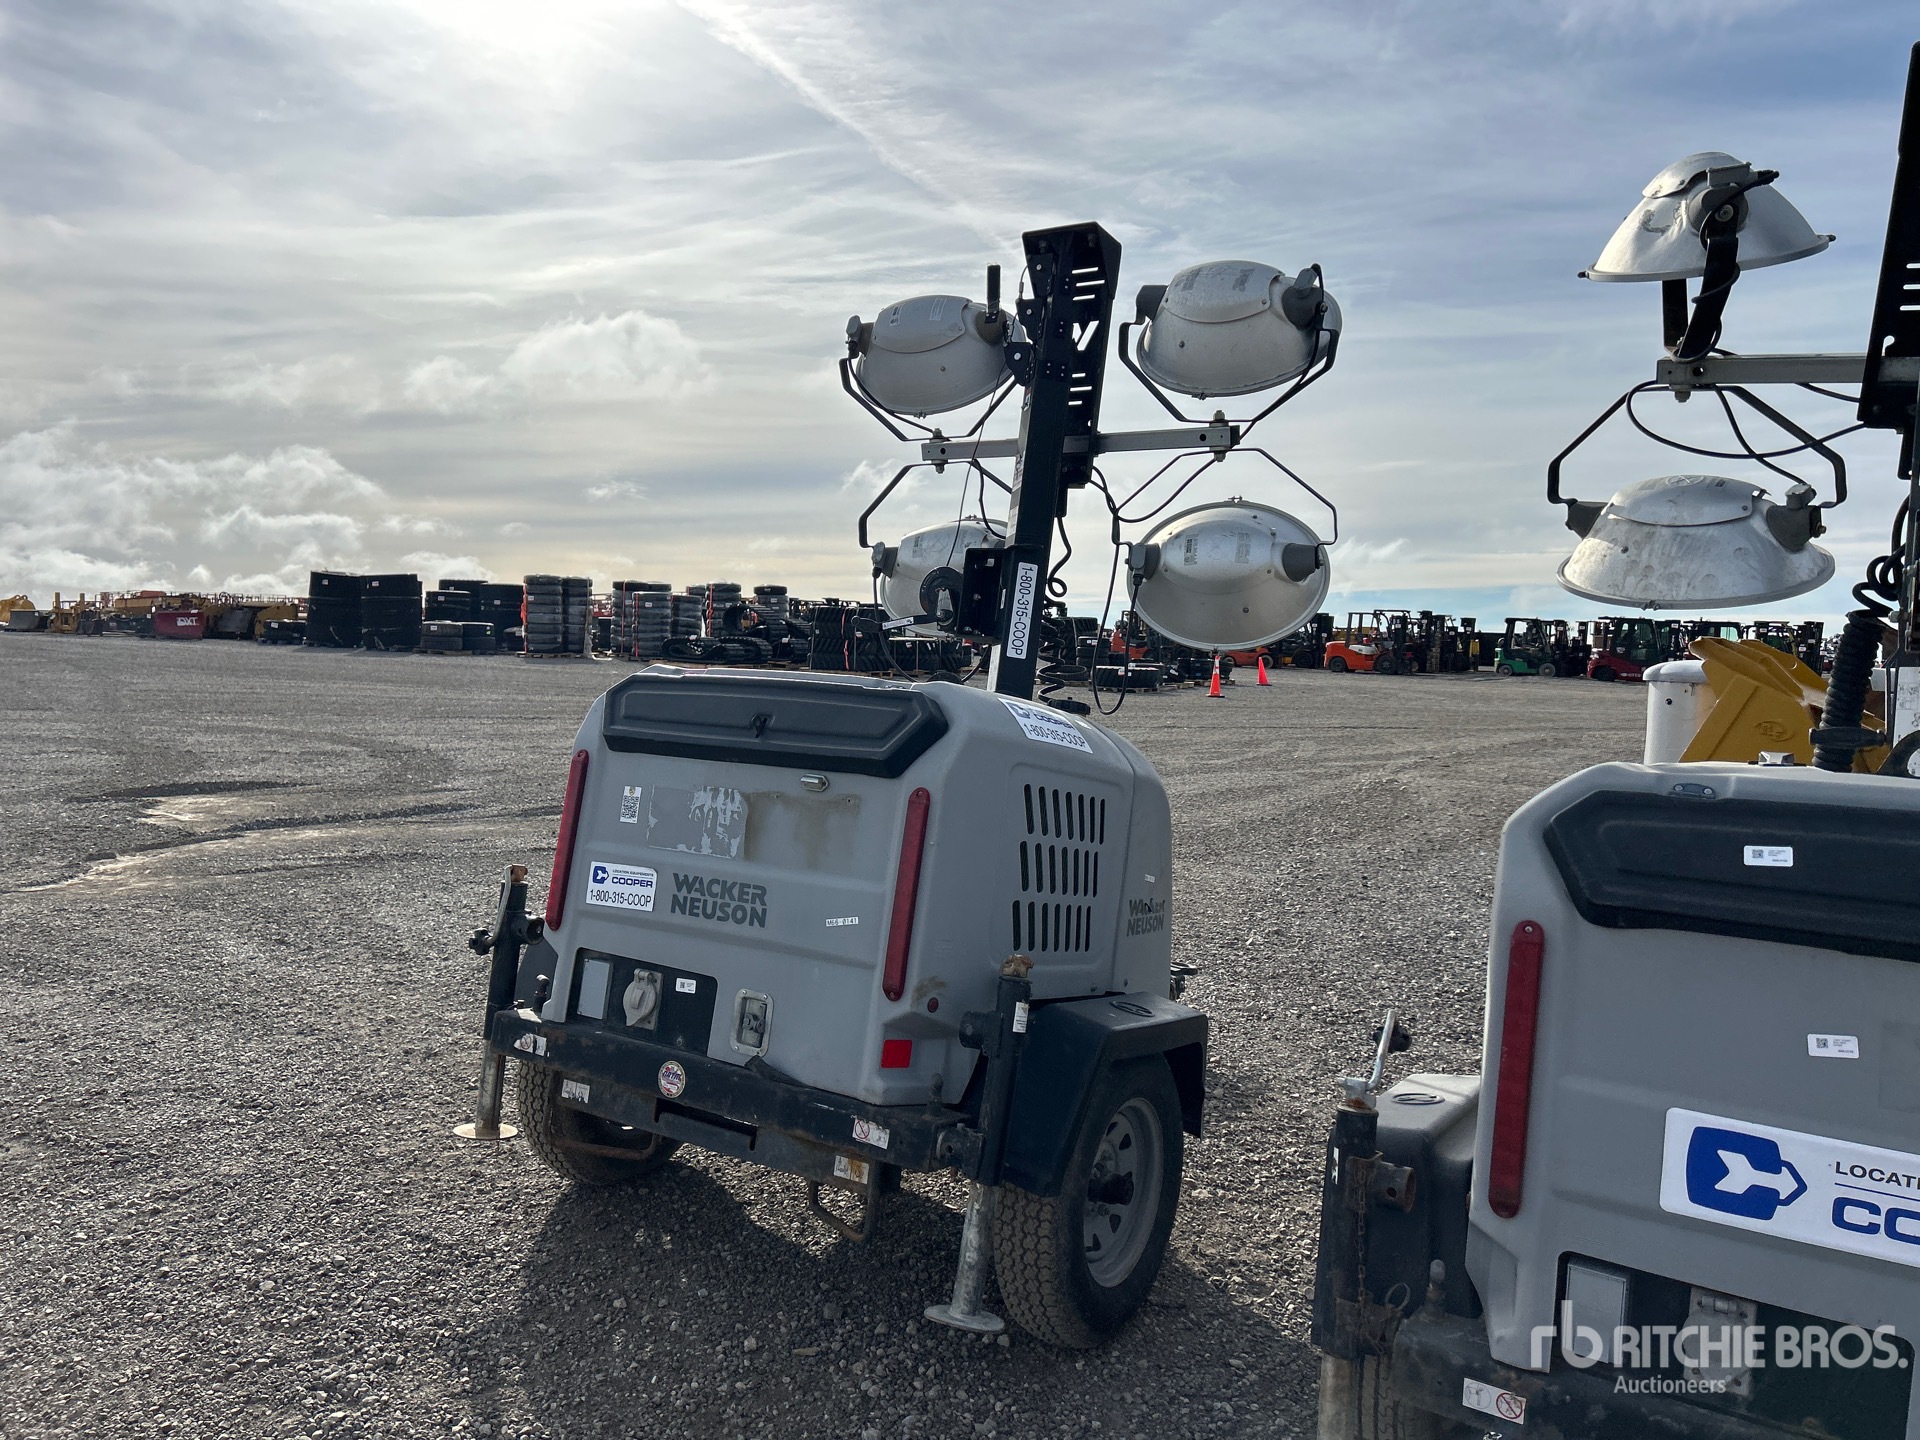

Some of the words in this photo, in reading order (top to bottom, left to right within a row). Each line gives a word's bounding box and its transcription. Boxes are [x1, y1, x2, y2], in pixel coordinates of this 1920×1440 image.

[1010, 566, 1034, 656] 1-800-315-COOP
[611, 876, 654, 889] COOPER
[672, 872, 768, 907] WACKER
[589, 889, 652, 907] 1-800-315-COOP
[670, 893, 768, 929] NEUSON
[1126, 914, 1166, 937] NEUSON
